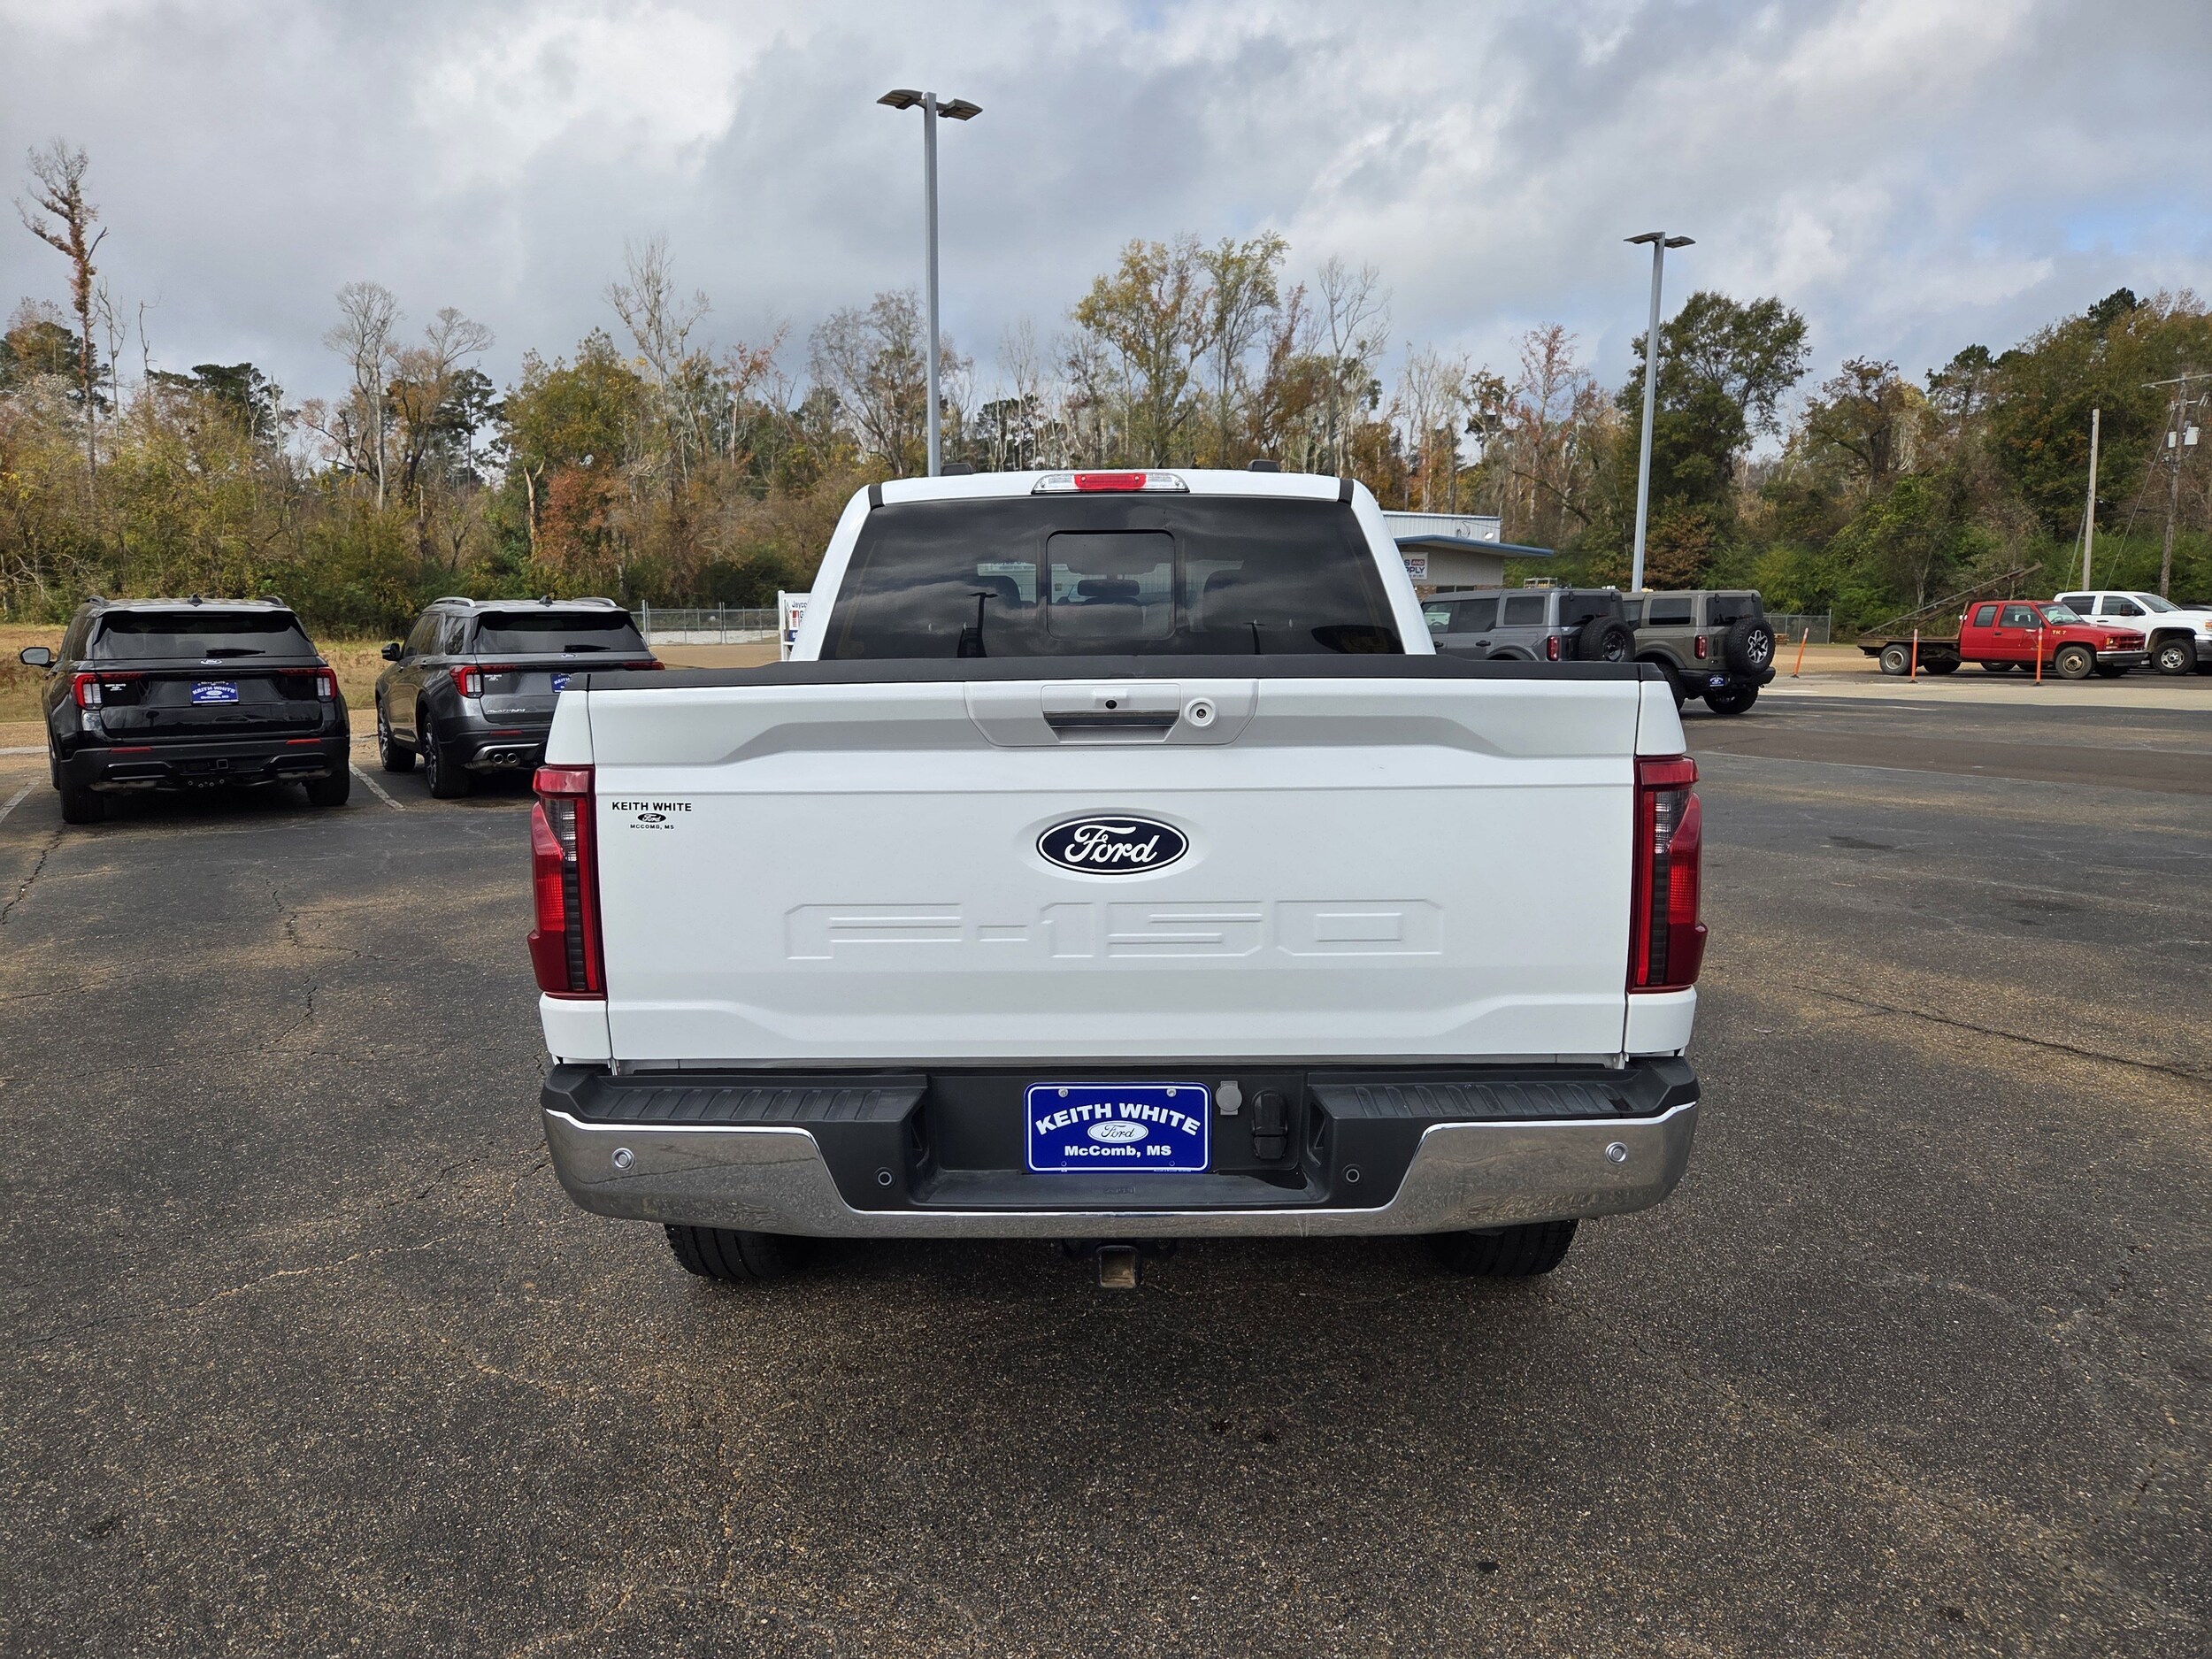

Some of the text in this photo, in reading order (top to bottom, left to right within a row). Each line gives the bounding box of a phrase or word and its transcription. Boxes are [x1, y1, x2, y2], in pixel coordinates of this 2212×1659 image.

[192, 686, 213, 695] KEITH
[611, 802, 692, 811] KEITH WHITE
[1064, 825, 1160, 863] Ford
[785, 899, 1444, 960] F-150
[1035, 1102, 1201, 1136] KEITH WHITE
[1101, 1124, 1136, 1139] Ford
[1064, 1145, 1171, 1158] McComb, MS
